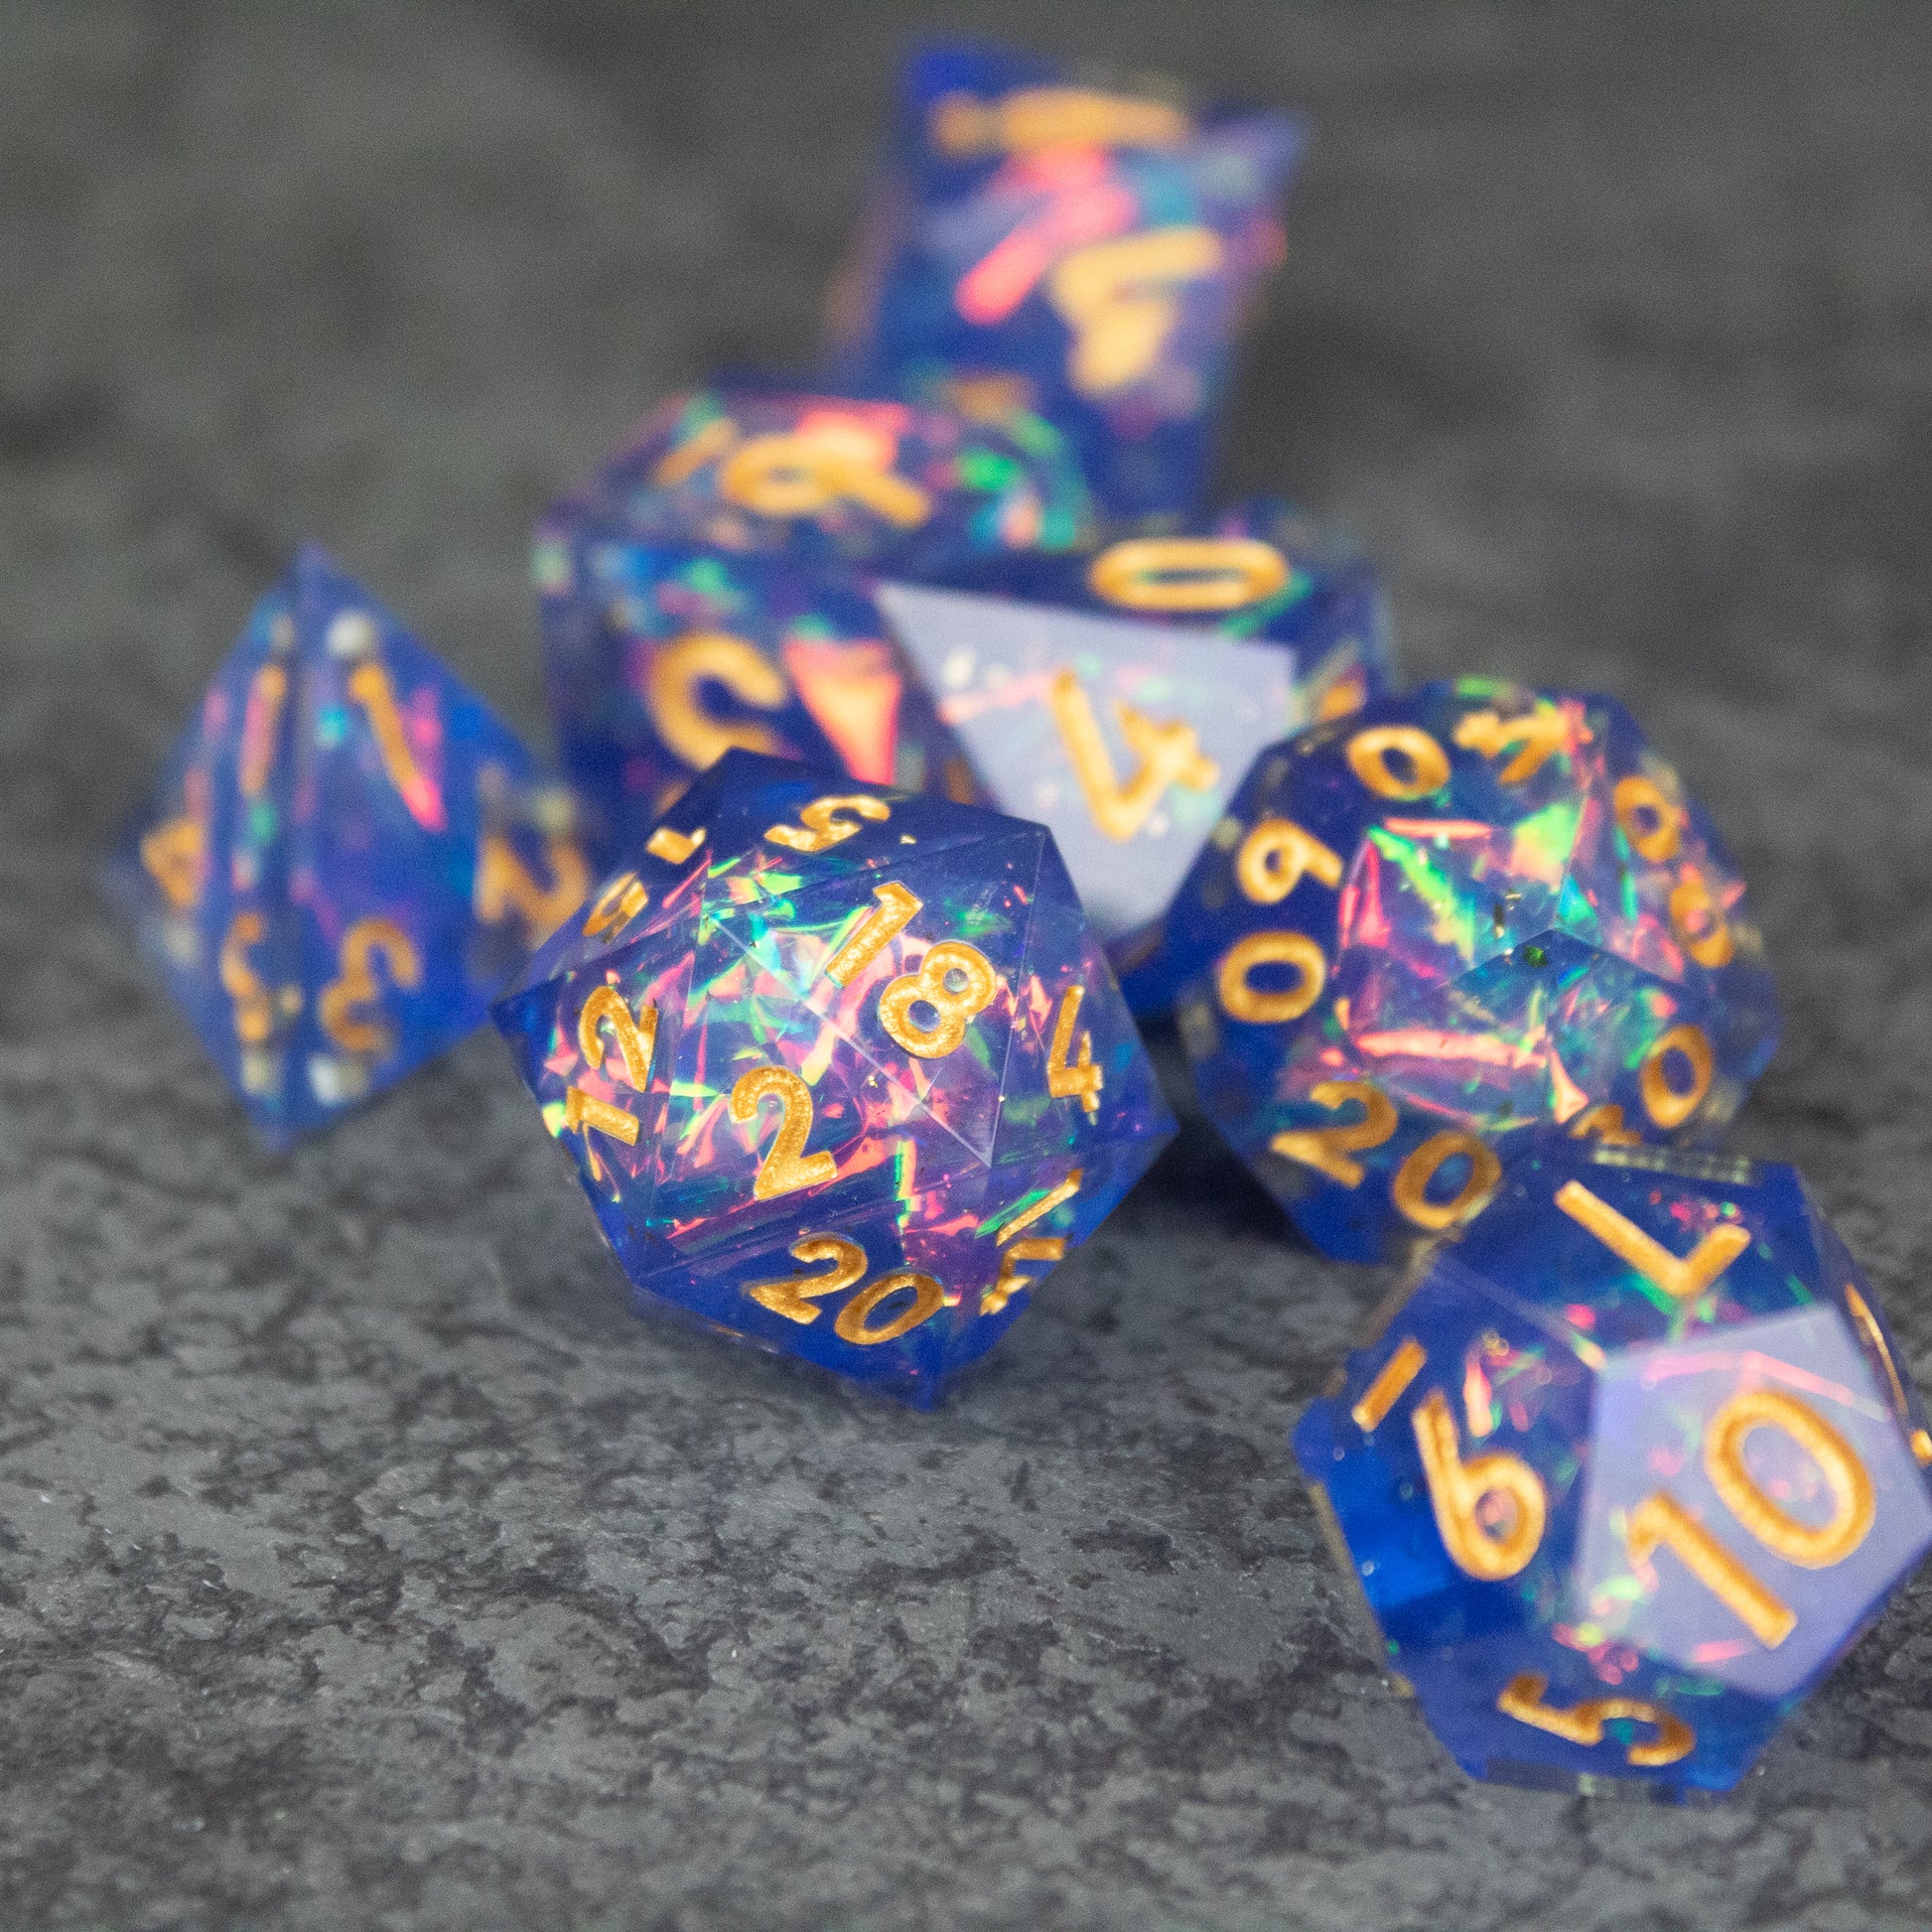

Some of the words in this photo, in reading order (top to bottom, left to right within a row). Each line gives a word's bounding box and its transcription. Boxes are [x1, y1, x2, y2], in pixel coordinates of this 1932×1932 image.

[1089, 537, 1291, 613] 0
[1048, 667, 1219, 842] 4
[824, 880, 997, 1059] 18
[564, 985, 659, 1147] 12
[1047, 985, 1103, 1113] 4
[730, 1064, 838, 1201] 2
[1273, 1080, 1501, 1229] 20
[743, 1233, 945, 1346] 20
[1626, 1390, 1878, 1650] 10
[1497, 1673, 1695, 1767] 5
